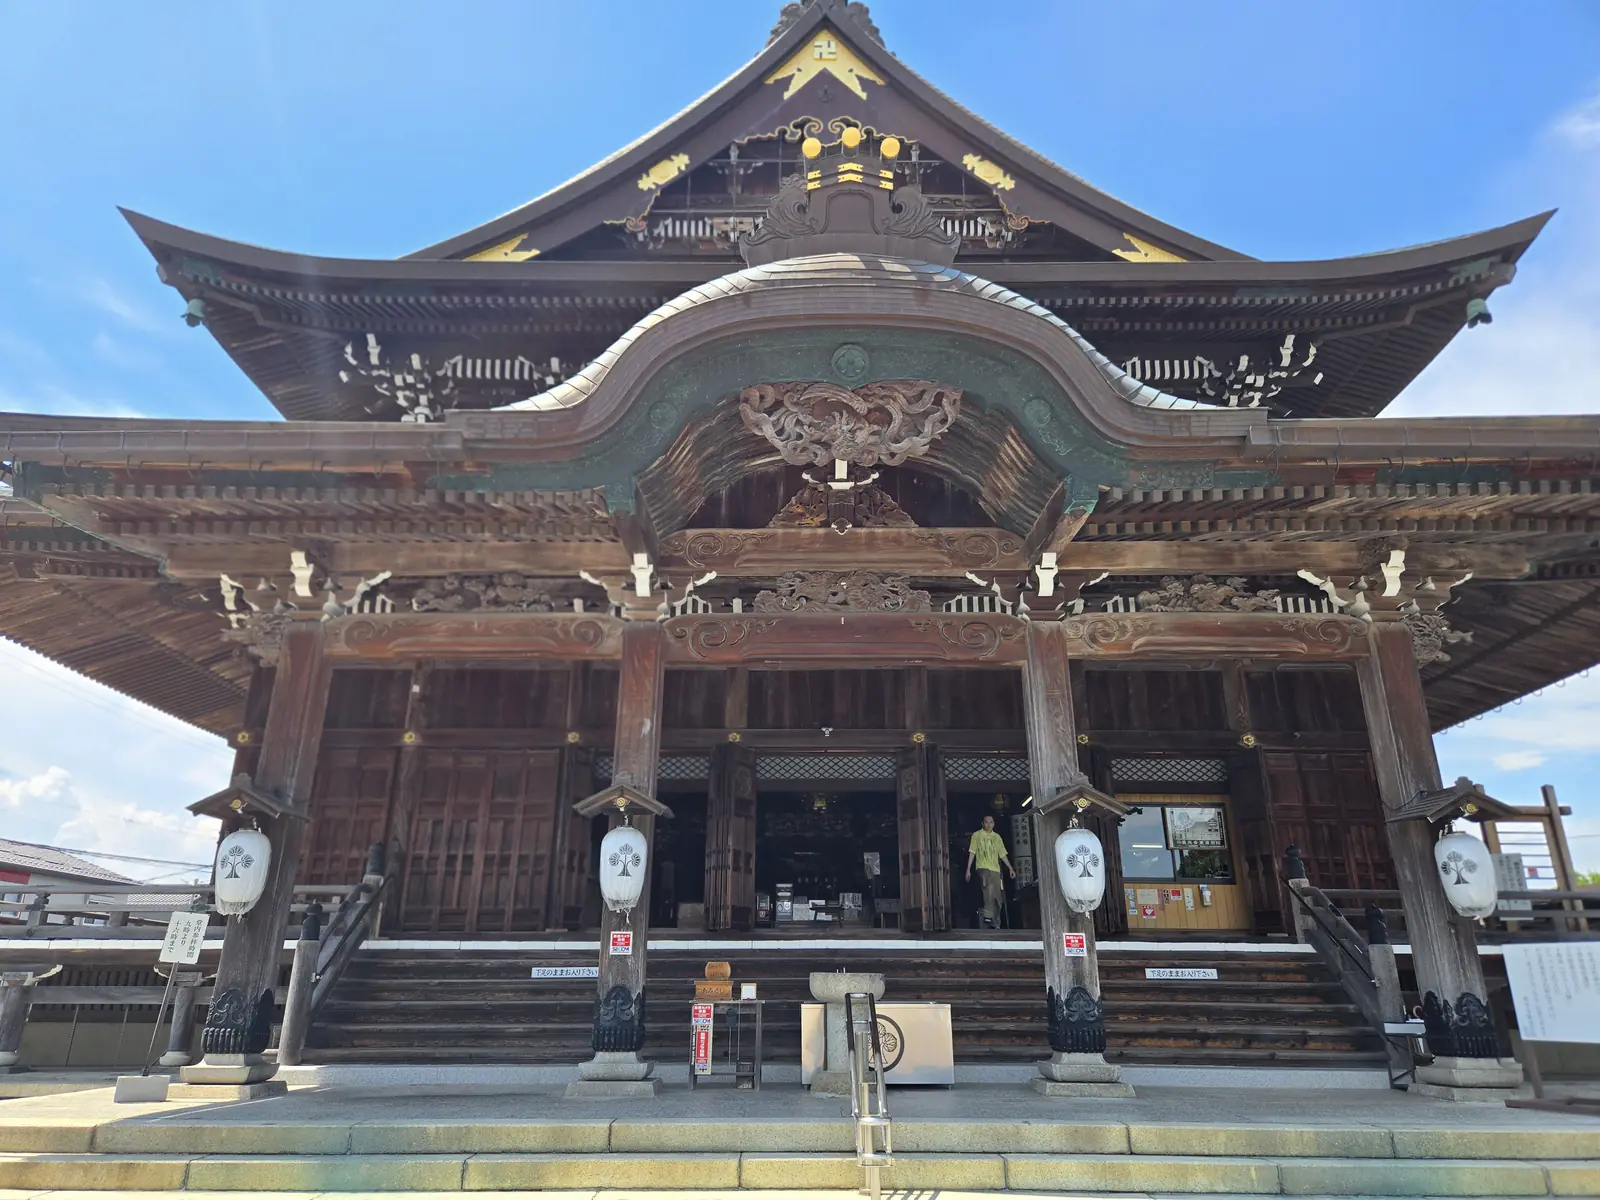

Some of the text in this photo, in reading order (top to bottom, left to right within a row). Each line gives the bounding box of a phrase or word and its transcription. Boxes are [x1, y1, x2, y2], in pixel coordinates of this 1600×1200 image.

[168, 920, 181, 954] 十六時まで
[181, 920, 192, 946] 九時より
[1150, 970, 1214, 978] 下足のままお入り下さい
